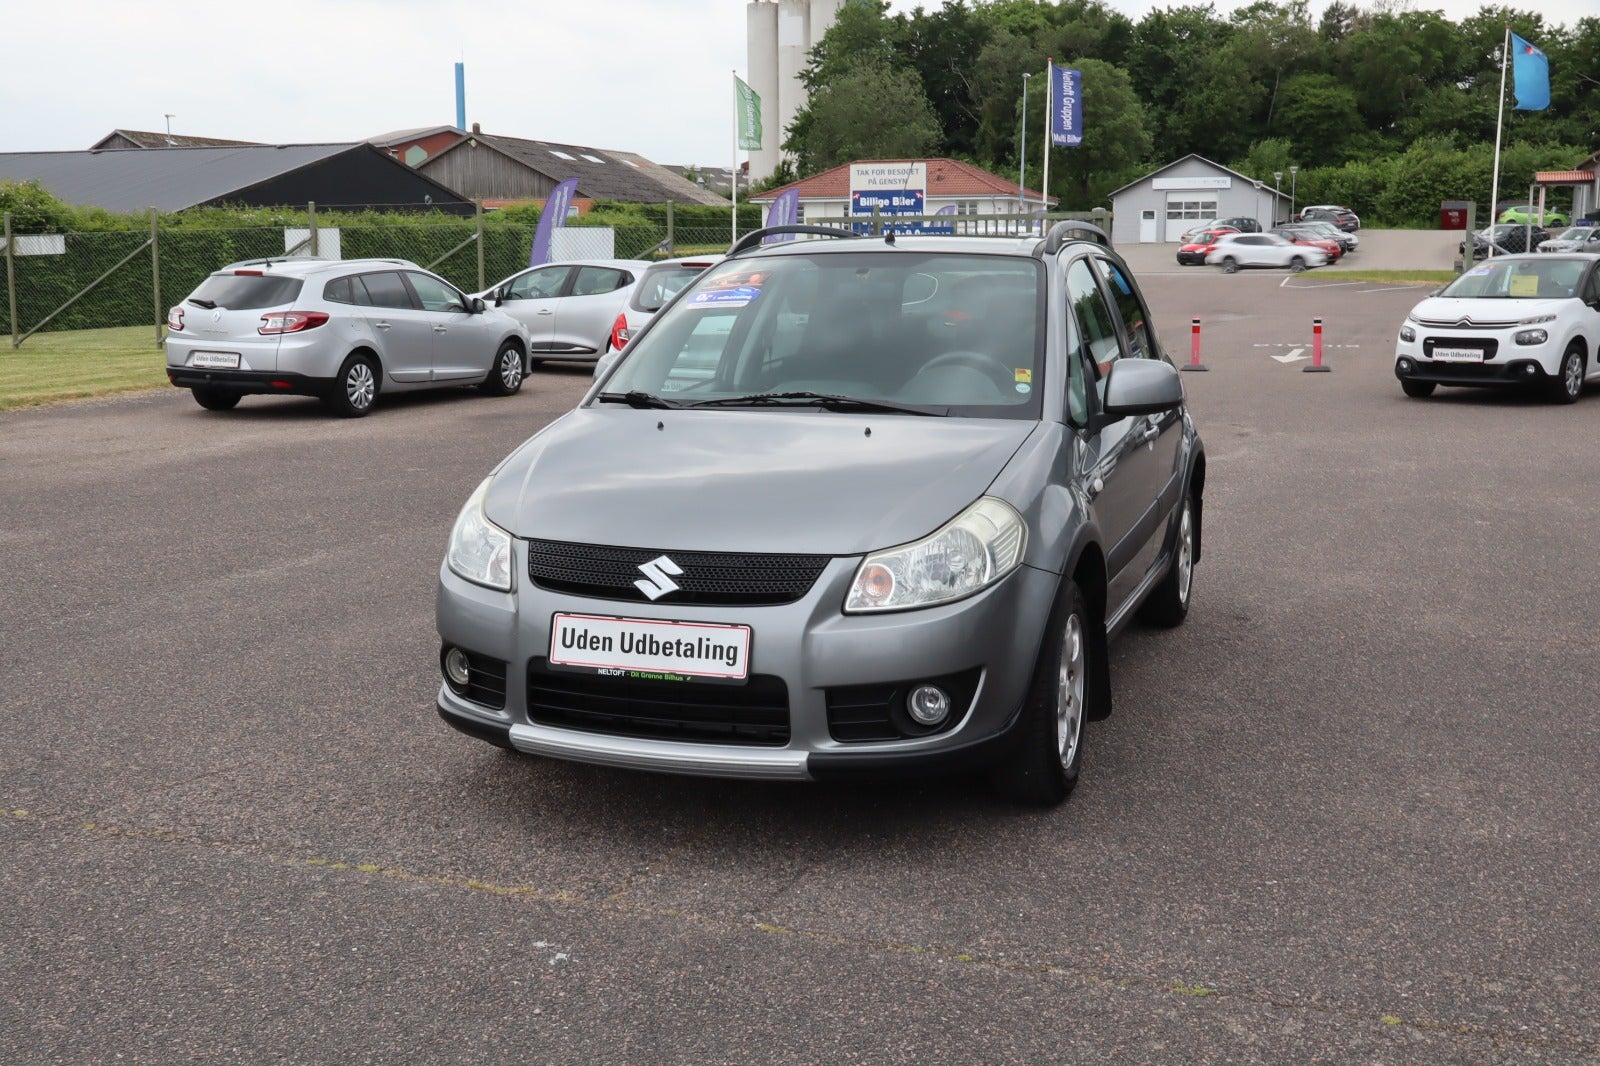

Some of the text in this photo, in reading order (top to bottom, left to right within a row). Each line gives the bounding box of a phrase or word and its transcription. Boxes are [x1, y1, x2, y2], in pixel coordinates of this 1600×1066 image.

[1061, 97, 1075, 130] Gruppen
[868, 177, 877, 185] PÅ
[860, 196, 915, 208] Billige Biler
[196, 353, 237, 363] Uden Udbetaling
[1450, 351, 1481, 359] Udbetaling
[561, 627, 738, 667] Uden Udbetaling
[597, 668, 625, 676] NELTOFT
